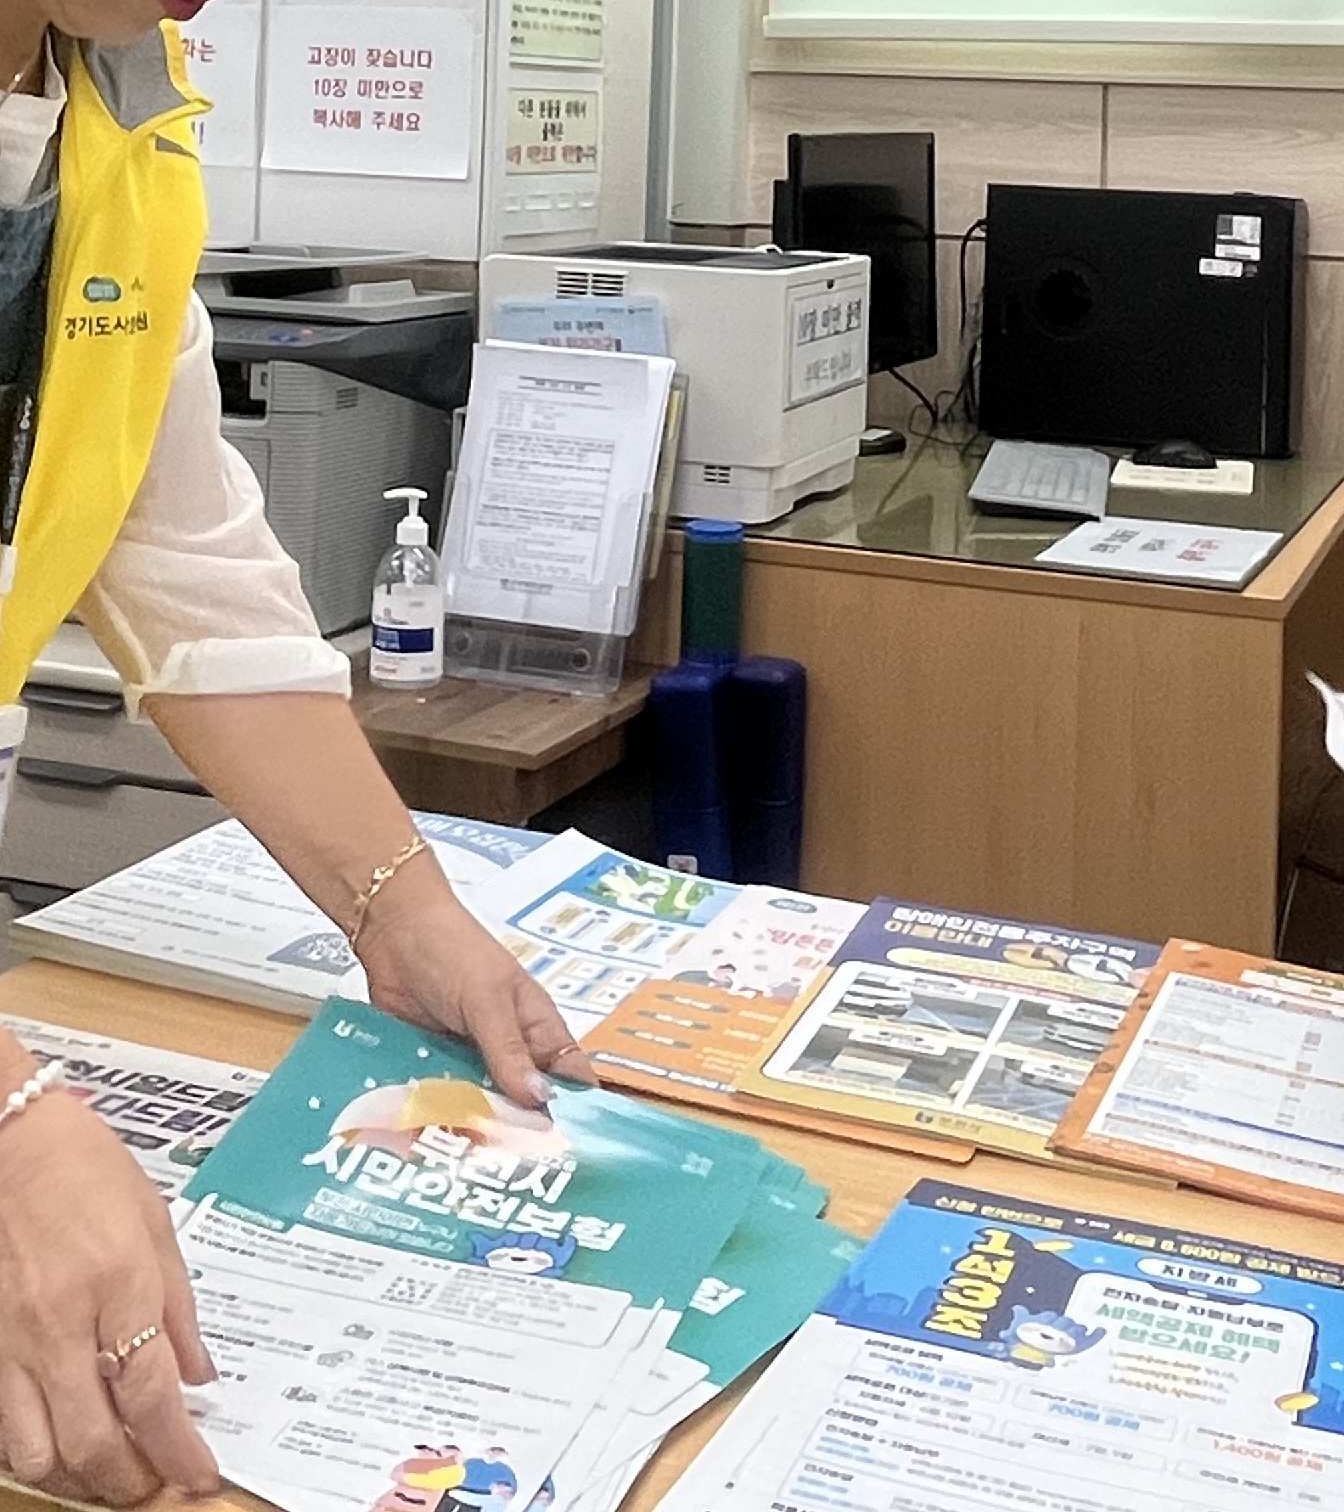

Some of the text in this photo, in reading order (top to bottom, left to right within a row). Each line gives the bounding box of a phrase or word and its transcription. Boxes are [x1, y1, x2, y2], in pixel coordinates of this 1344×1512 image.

[307, 46, 356, 68] 고장이
[314, 78, 424, 100] 10장 미만으로
[313, 109, 421, 132] 복사해 주세요
[302, 1136, 627, 1252] 시민안전보험
